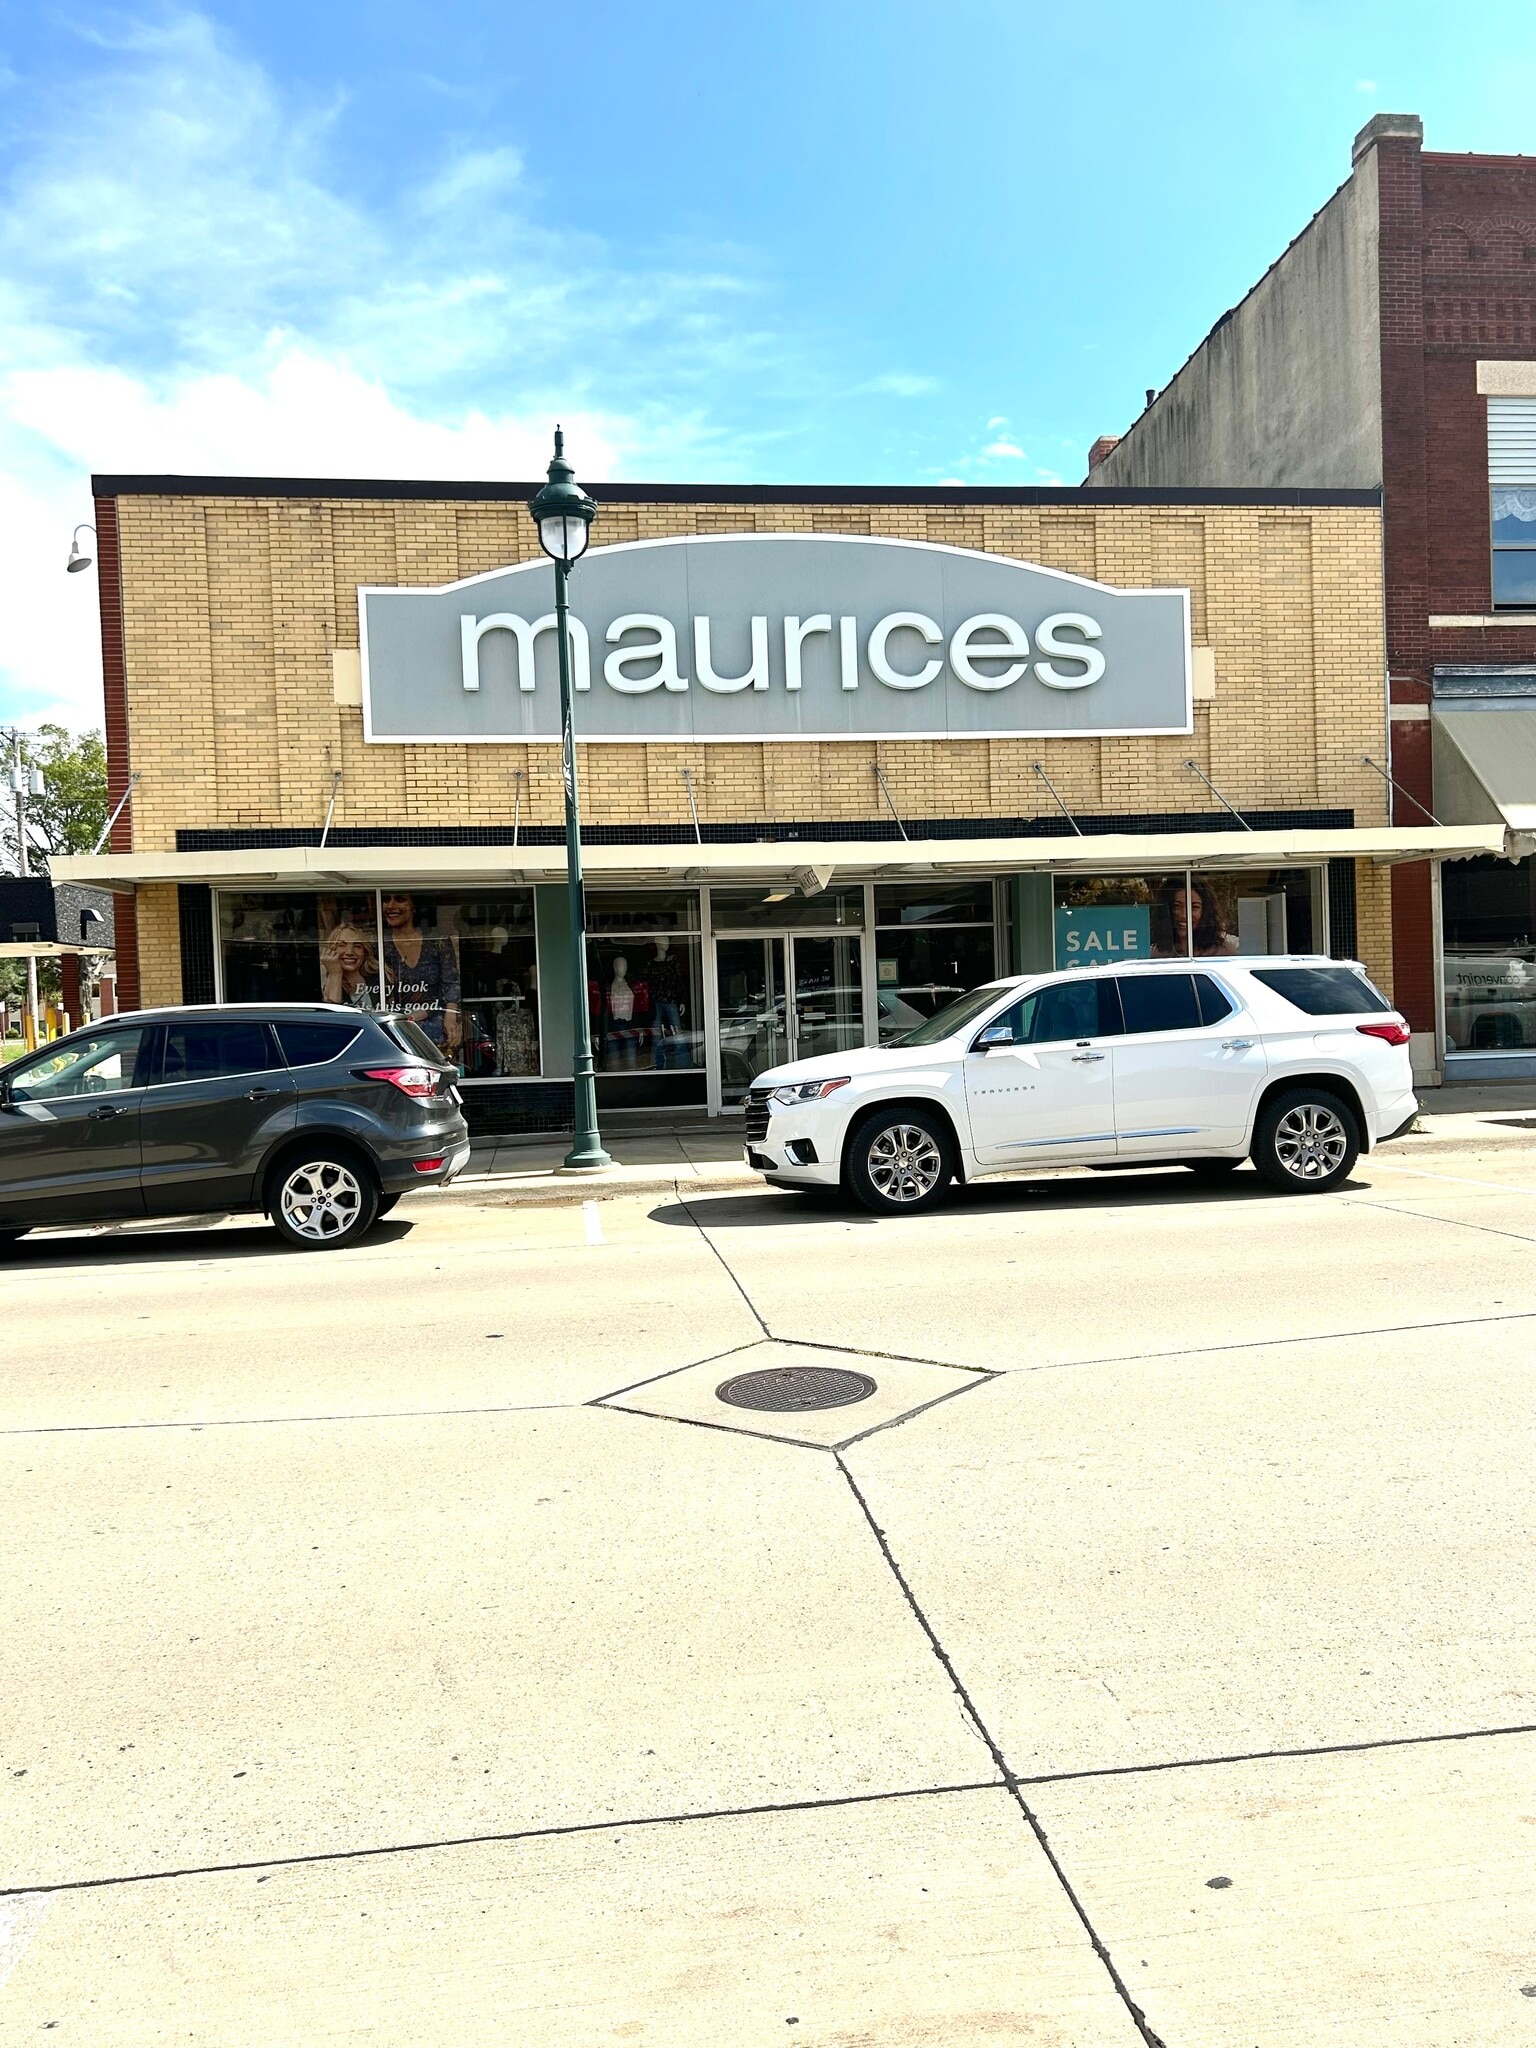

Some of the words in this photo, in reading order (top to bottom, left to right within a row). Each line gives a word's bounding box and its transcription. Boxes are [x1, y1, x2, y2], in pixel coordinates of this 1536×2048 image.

[461, 611, 1106, 693] maurices
[1066, 930, 1138, 952] SALE
[355, 982, 395, 997] Evey
[398, 981, 428, 993] look
[403, 999, 443, 1014] good.
